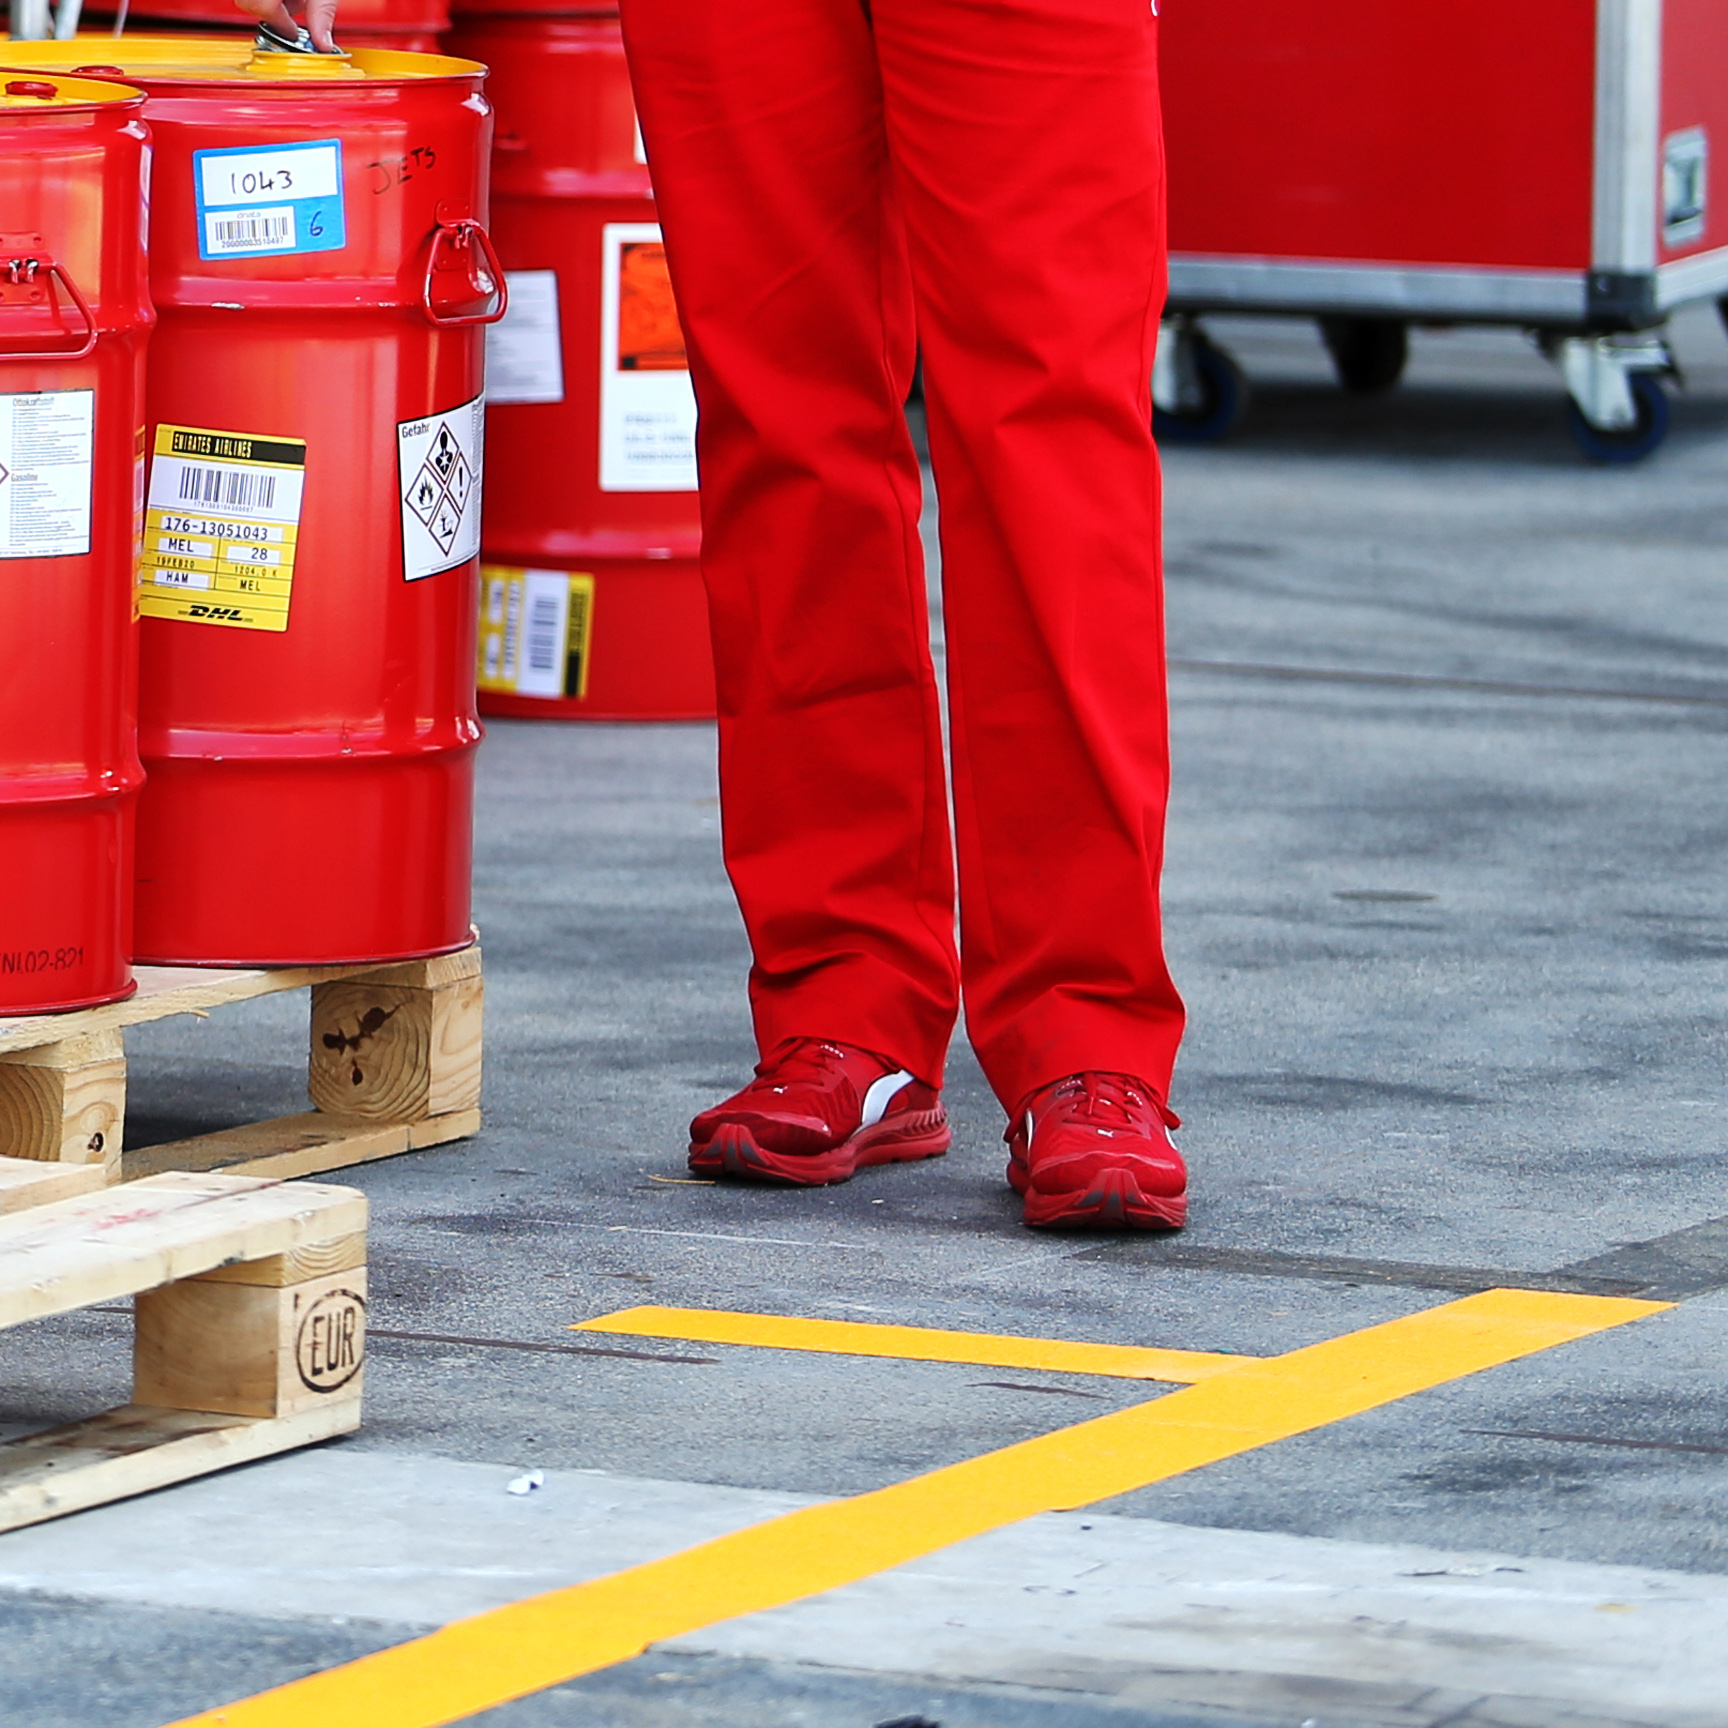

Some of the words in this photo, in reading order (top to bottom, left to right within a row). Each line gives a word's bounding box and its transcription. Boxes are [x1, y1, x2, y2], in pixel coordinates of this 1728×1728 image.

[230, 170, 293, 194] 1043
[366, 146, 436, 195] JETS
[309, 211, 324, 237] 6
[402, 422, 431, 438] Gefahr
[174, 433, 211, 454] EMIRATES
[214, 437, 252, 458] AIRLINES
[11, 473, 38, 483] Gasoline
[165, 517, 268, 541] 176-13051043
[168, 538, 194, 553] MEL
[251, 547, 268, 561] 28
[166, 571, 189, 584] HAM
[240, 579, 261, 592] MEL
[188, 605, 244, 621] DHL
[311, 1306, 355, 1377] EUR
